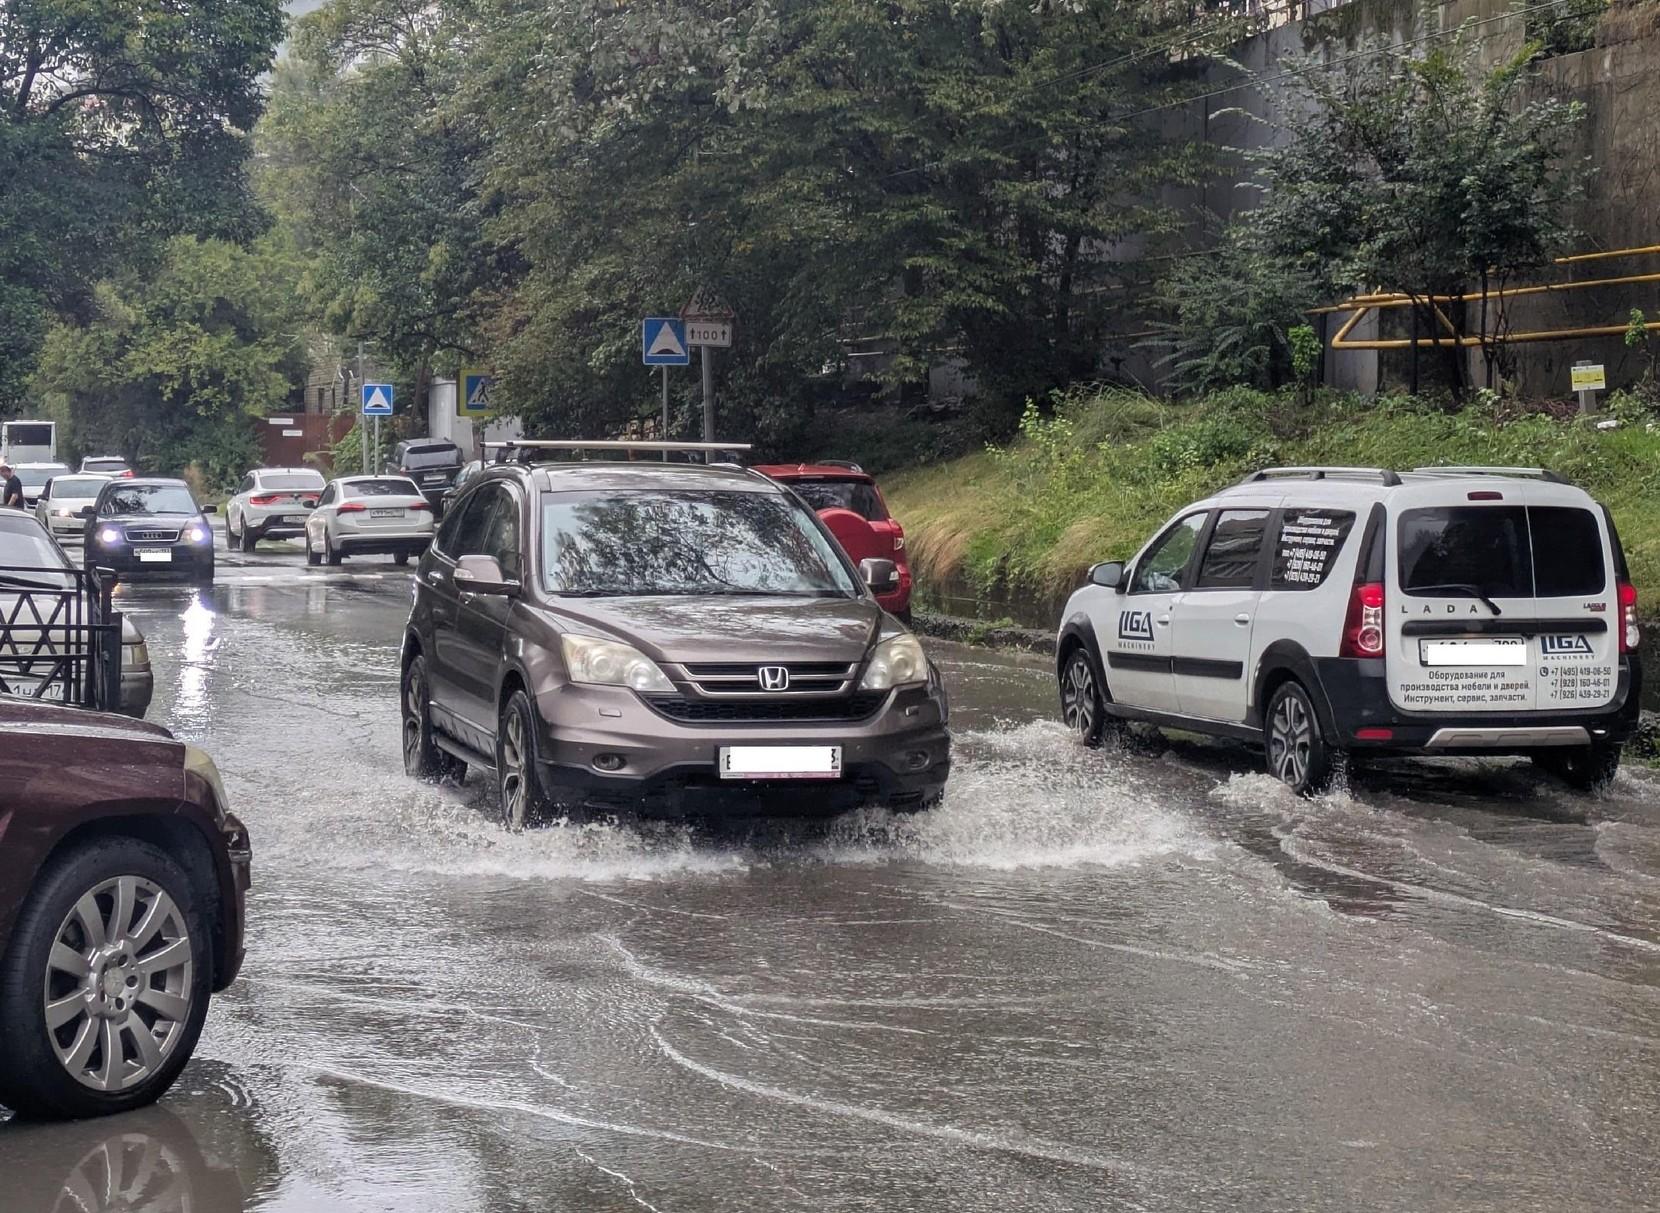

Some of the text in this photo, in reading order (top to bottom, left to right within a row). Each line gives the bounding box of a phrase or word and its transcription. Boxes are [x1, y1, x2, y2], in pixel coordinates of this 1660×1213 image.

[697, 330, 718, 340] 100
[1400, 604, 1478, 614] LADA
[1118, 610, 1155, 641] LIGA
[1540, 634, 1595, 655] LIGA
[1428, 671, 1505, 681] Оборудование для
[1560, 666, 1578, 677] (495)
[1400, 683, 1459, 692] производства
[1461, 682, 1492, 691] мебели
[1403, 694, 1455, 704] Инструмент,
[1456, 694, 1487, 703] сервис,
[1559, 689, 1578, 700] (926)
